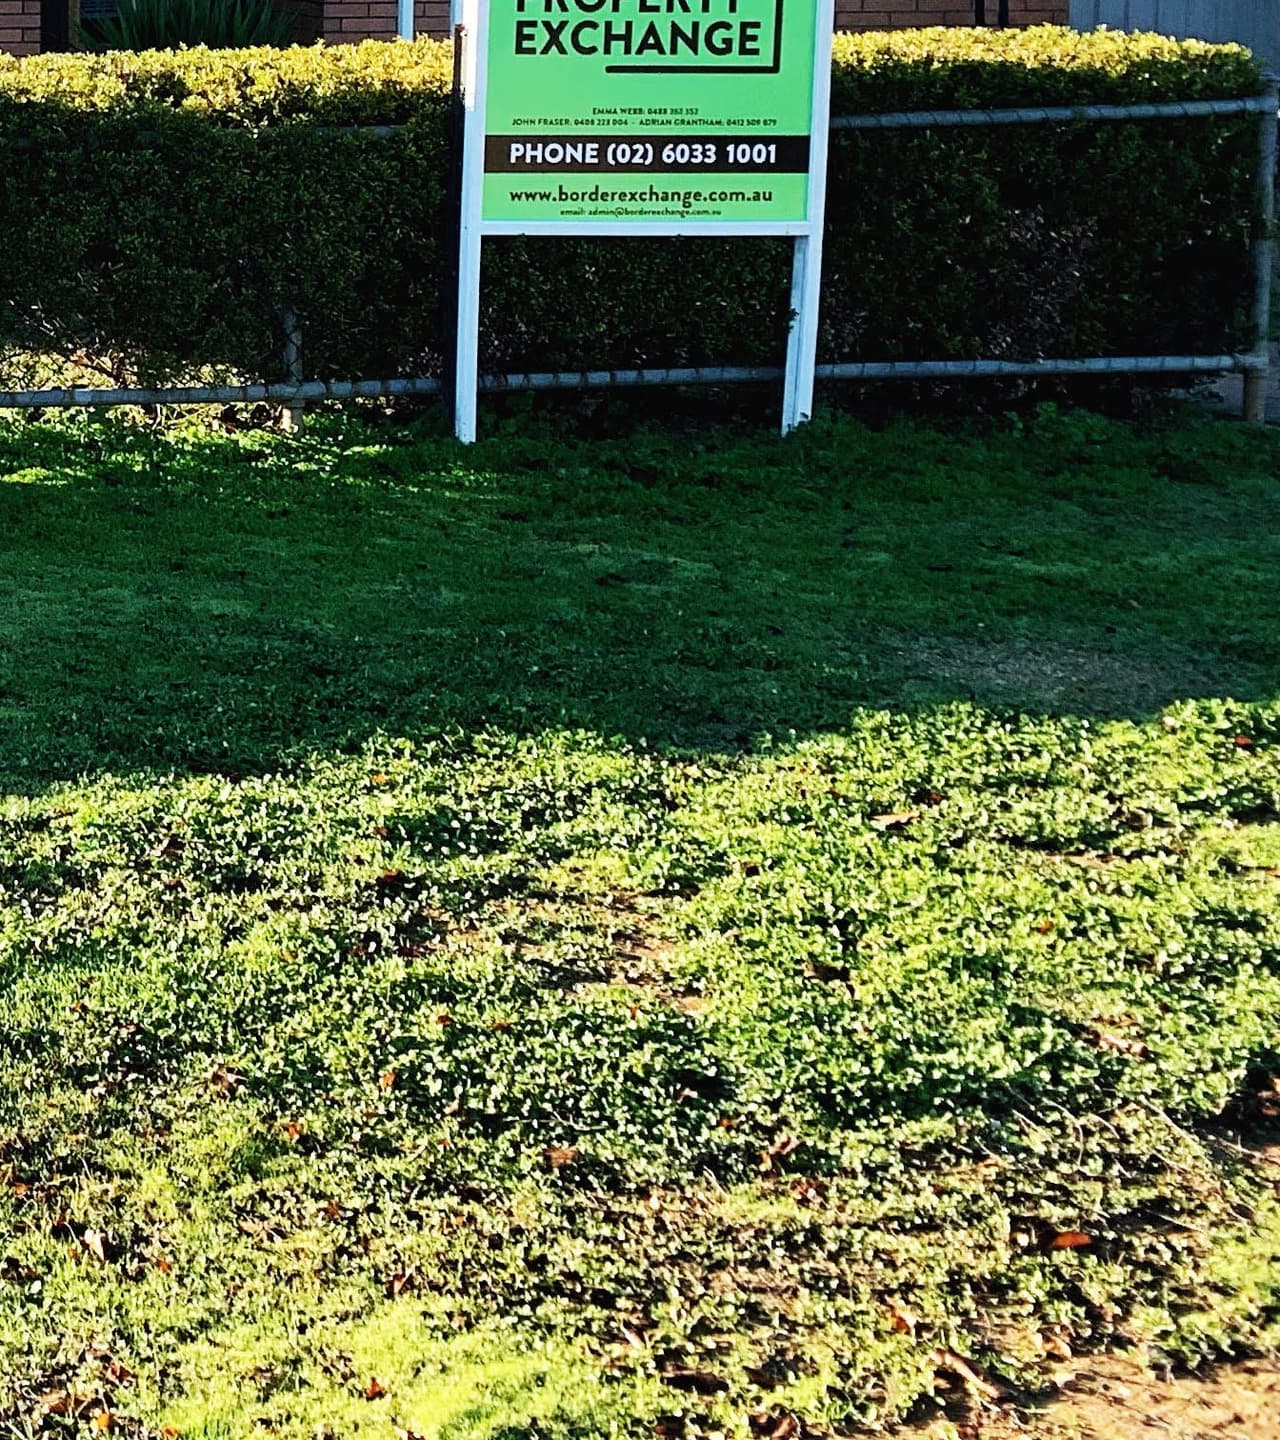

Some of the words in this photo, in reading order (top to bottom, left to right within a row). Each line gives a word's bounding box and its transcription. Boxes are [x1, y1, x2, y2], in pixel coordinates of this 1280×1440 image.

[513, 20, 762, 57] EXCHANGE
[592, 107, 617, 115] EMMA
[512, 118, 536, 126] JOHN
[639, 118, 672, 126] ADRIAN
[509, 143, 600, 165] PHONE
[607, 143, 654, 167] (02)
[661, 143, 717, 164] 6033
[726, 143, 777, 164] 1001
[509, 184, 773, 208] www.borderexchange.com.au
[560, 207, 586, 216] email:
